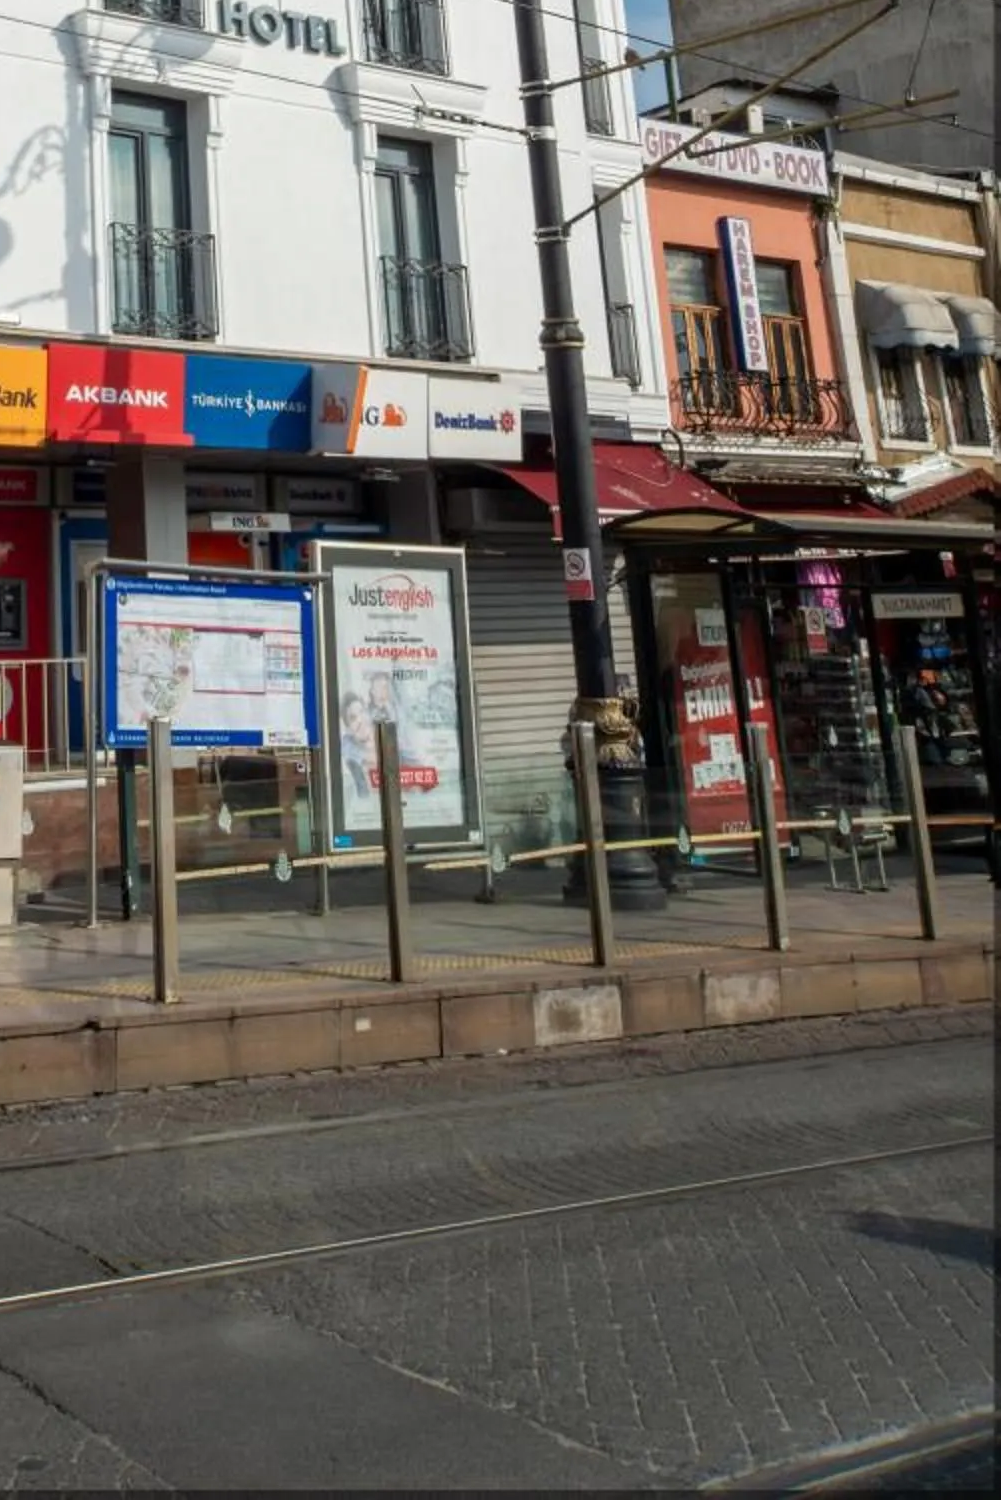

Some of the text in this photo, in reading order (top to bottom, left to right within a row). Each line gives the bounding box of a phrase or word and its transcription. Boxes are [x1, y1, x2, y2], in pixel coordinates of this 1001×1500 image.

[773, 151, 825, 187] BOOK
[732, 221, 762, 368] HAREM SHOP
[65, 384, 168, 408] AKBANK
[191, 392, 307, 413] TÜRKİYE BANKASI
[434, 411, 497, 432] DenizBank
[232, 515, 255, 529] ING
[352, 646, 374, 658] Los
